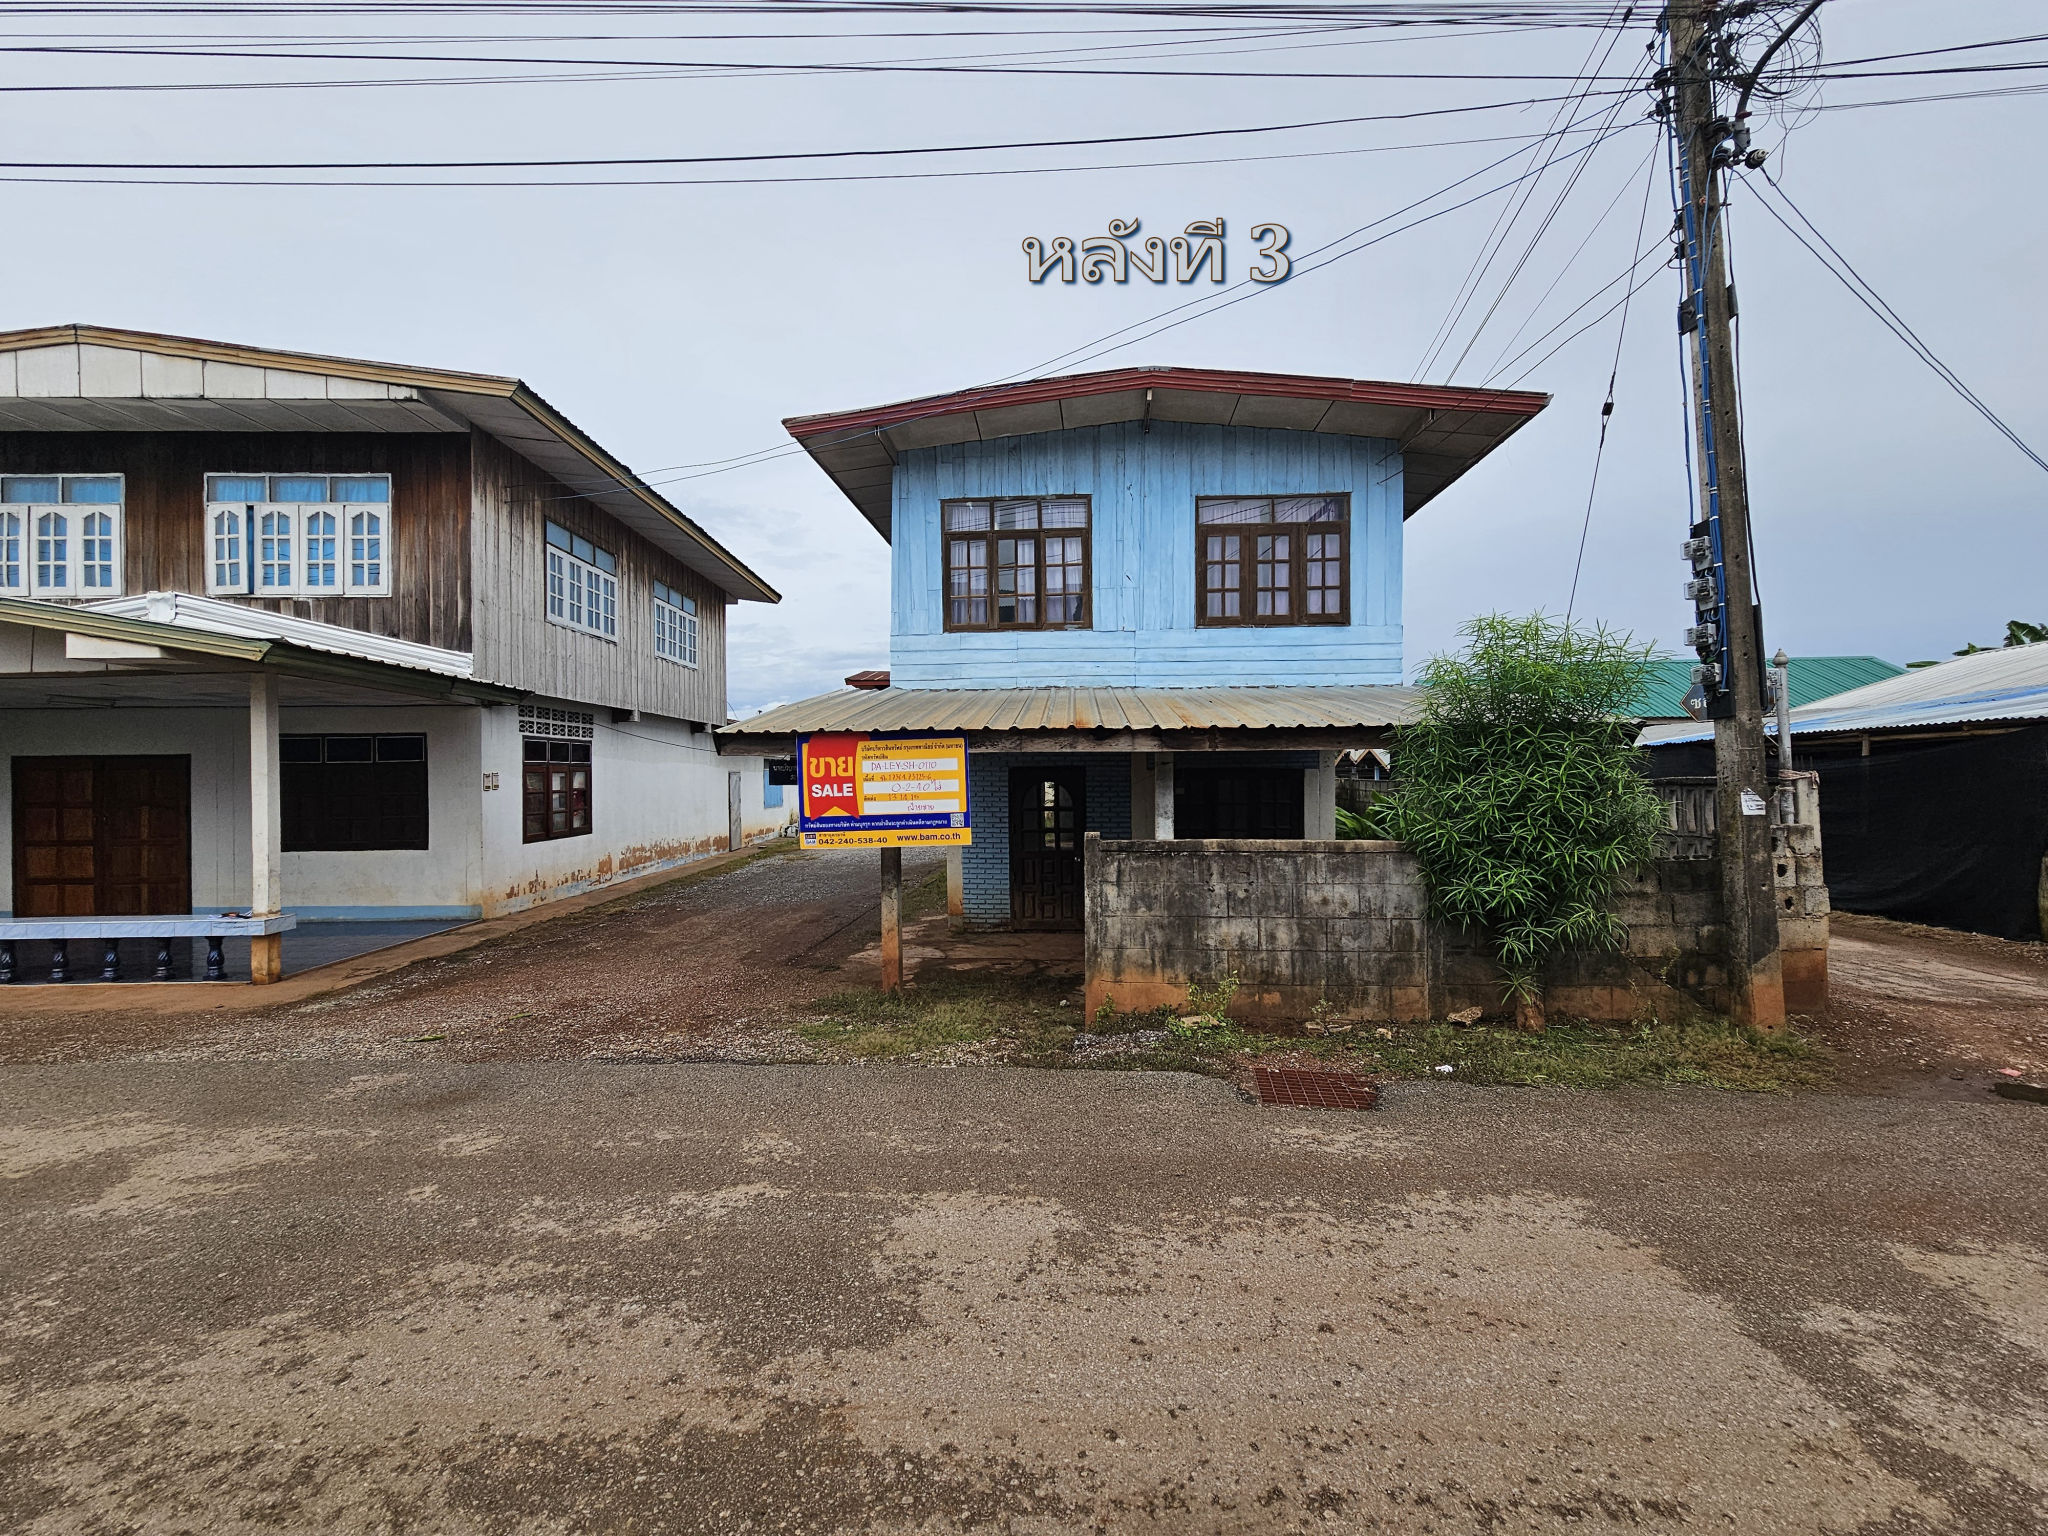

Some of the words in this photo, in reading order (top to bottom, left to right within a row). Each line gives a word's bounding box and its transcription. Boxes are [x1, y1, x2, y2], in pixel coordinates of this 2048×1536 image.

[809, 756, 853, 778] ขาย
[811, 783, 853, 798] SALE
[818, 837, 888, 845] 042-240-538-40
[896, 832, 961, 841] www.bam.co.th
